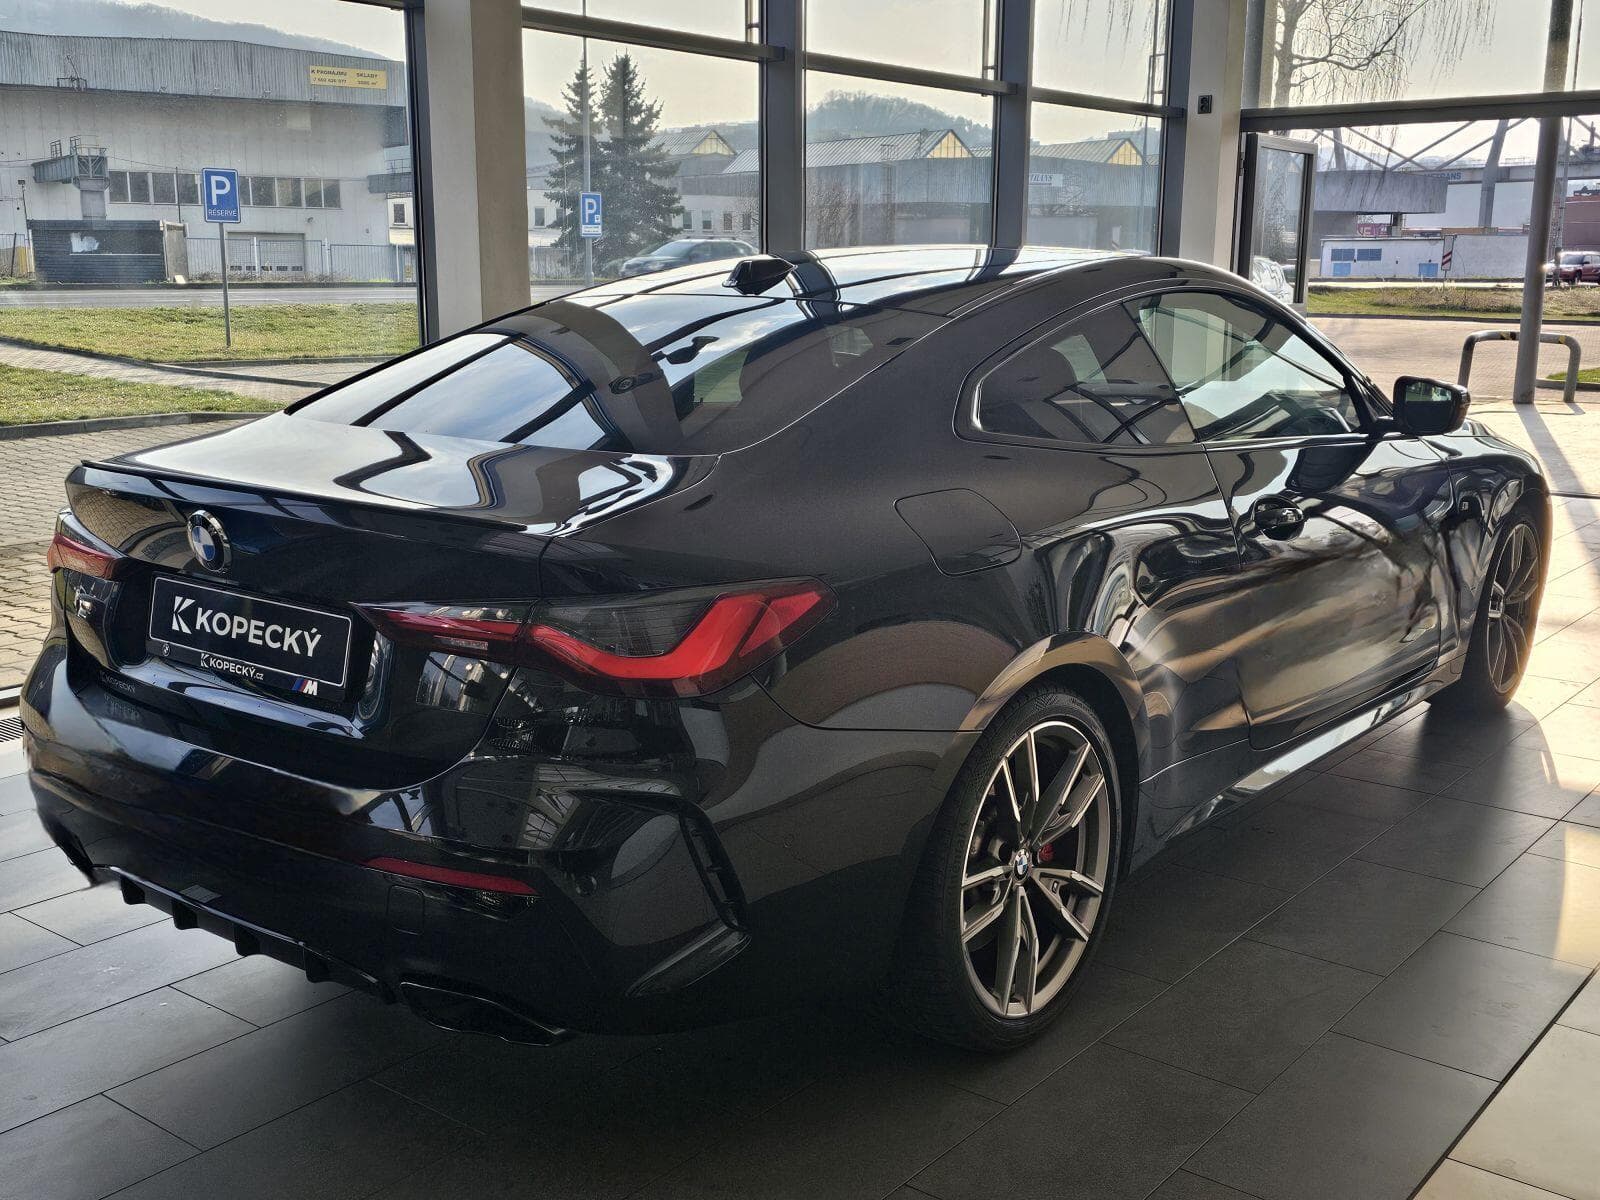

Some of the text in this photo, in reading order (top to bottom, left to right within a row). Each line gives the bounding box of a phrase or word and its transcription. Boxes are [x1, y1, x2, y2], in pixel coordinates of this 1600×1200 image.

[211, 175, 231, 206] P
[585, 198, 597, 224] P
[195, 607, 322, 658] KOPECKÝ
